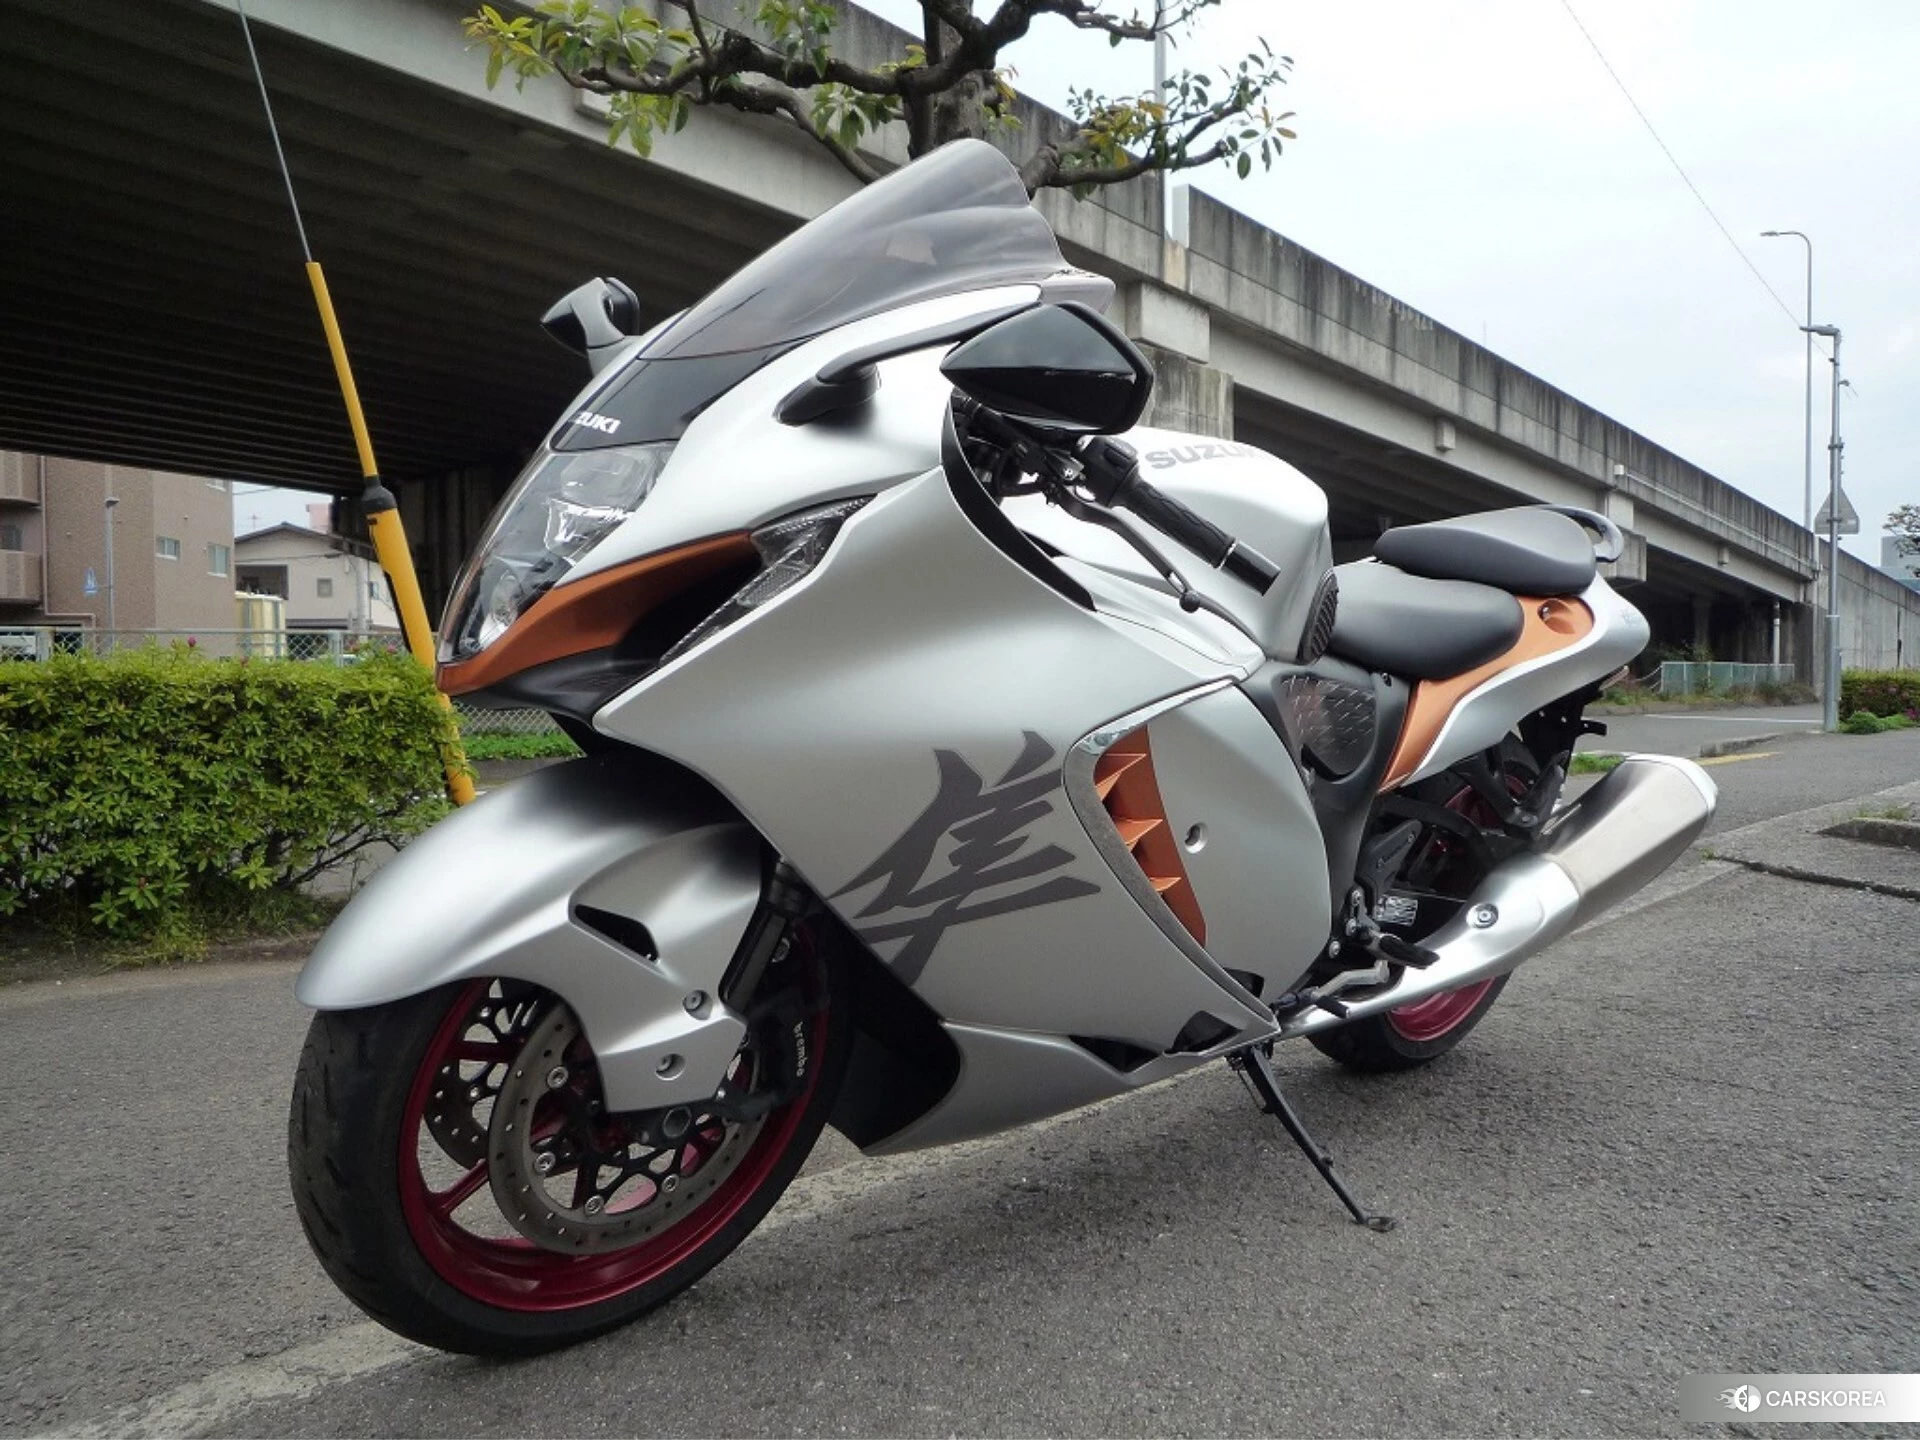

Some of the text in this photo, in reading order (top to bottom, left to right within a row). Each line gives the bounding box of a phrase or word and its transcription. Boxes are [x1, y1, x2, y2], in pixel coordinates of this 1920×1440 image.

[575, 411, 621, 434] ZUKI
[1145, 443, 1259, 469] SUZU
[793, 1020, 808, 1078] brembo
